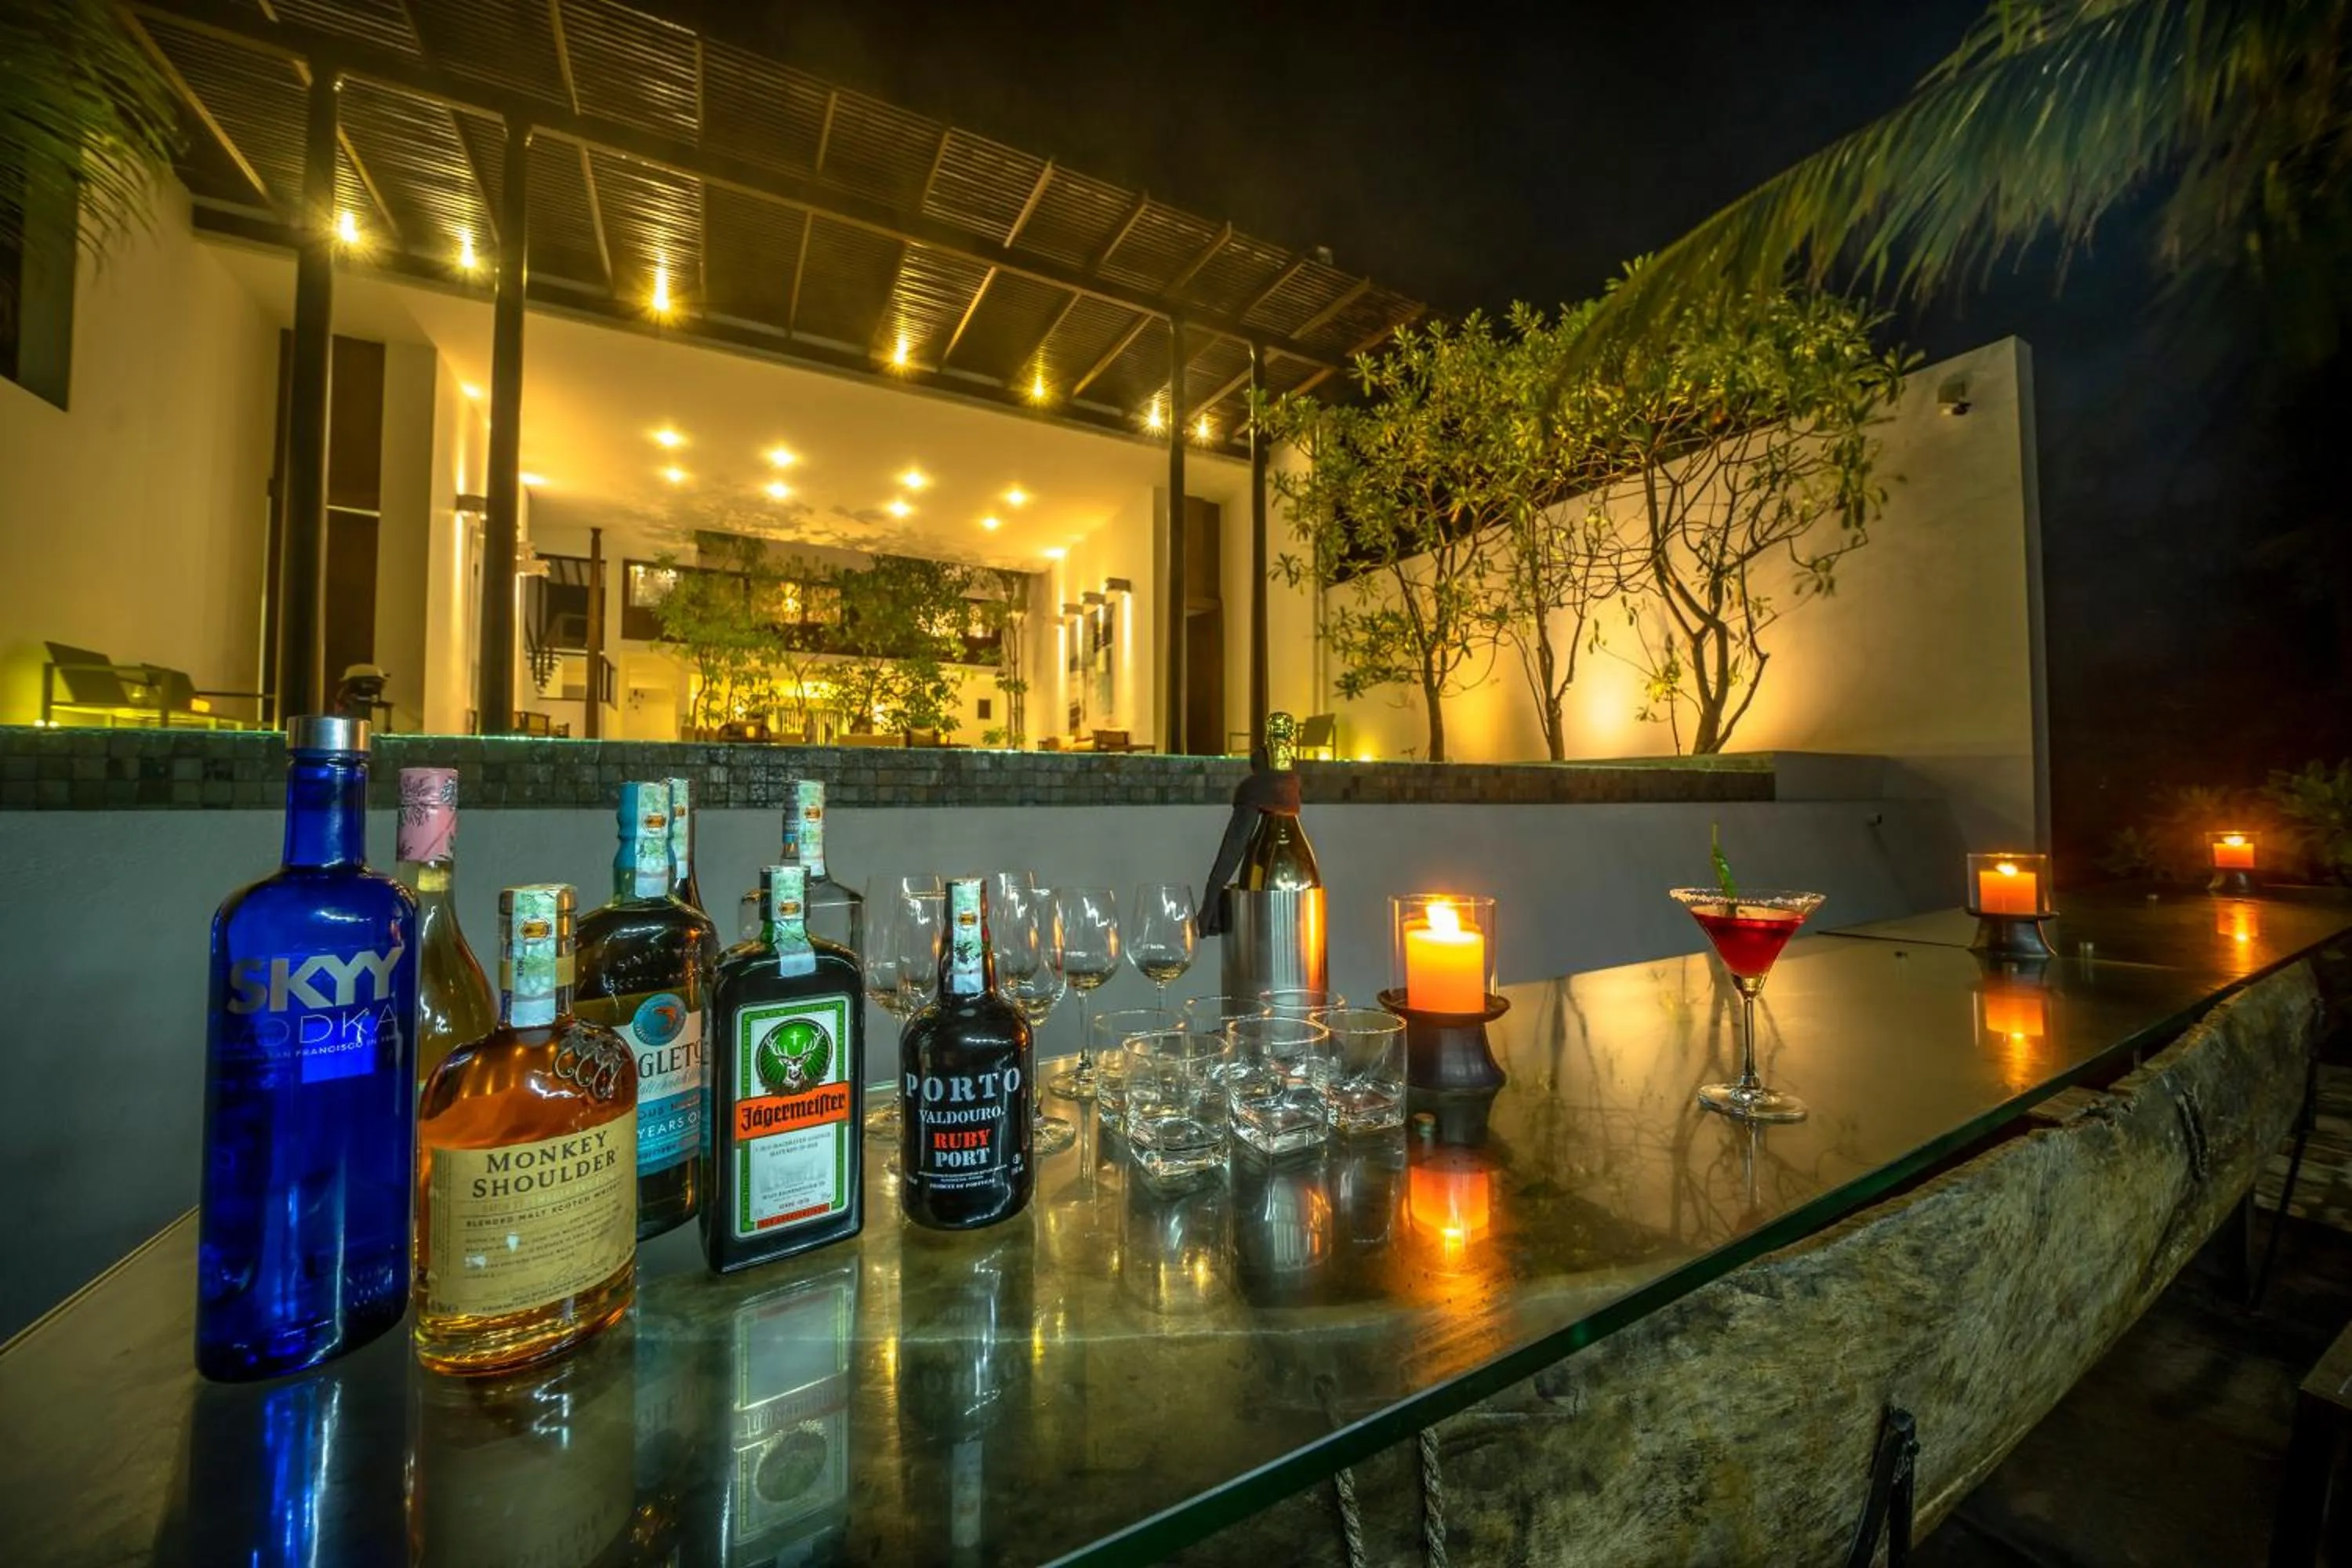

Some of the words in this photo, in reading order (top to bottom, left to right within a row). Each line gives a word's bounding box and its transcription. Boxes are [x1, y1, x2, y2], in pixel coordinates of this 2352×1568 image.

[227, 942, 405, 1014] SKYY
[906, 1067, 1020, 1102] PORTO
[637, 1116, 684, 1139] YEARS
[741, 1092, 846, 1131] Jägermeister
[486, 1131, 608, 1174] MONKEY
[933, 1128, 991, 1149] RUBY
[472, 1149, 616, 1198] SHOULDER
[935, 1148, 991, 1167] PORT
